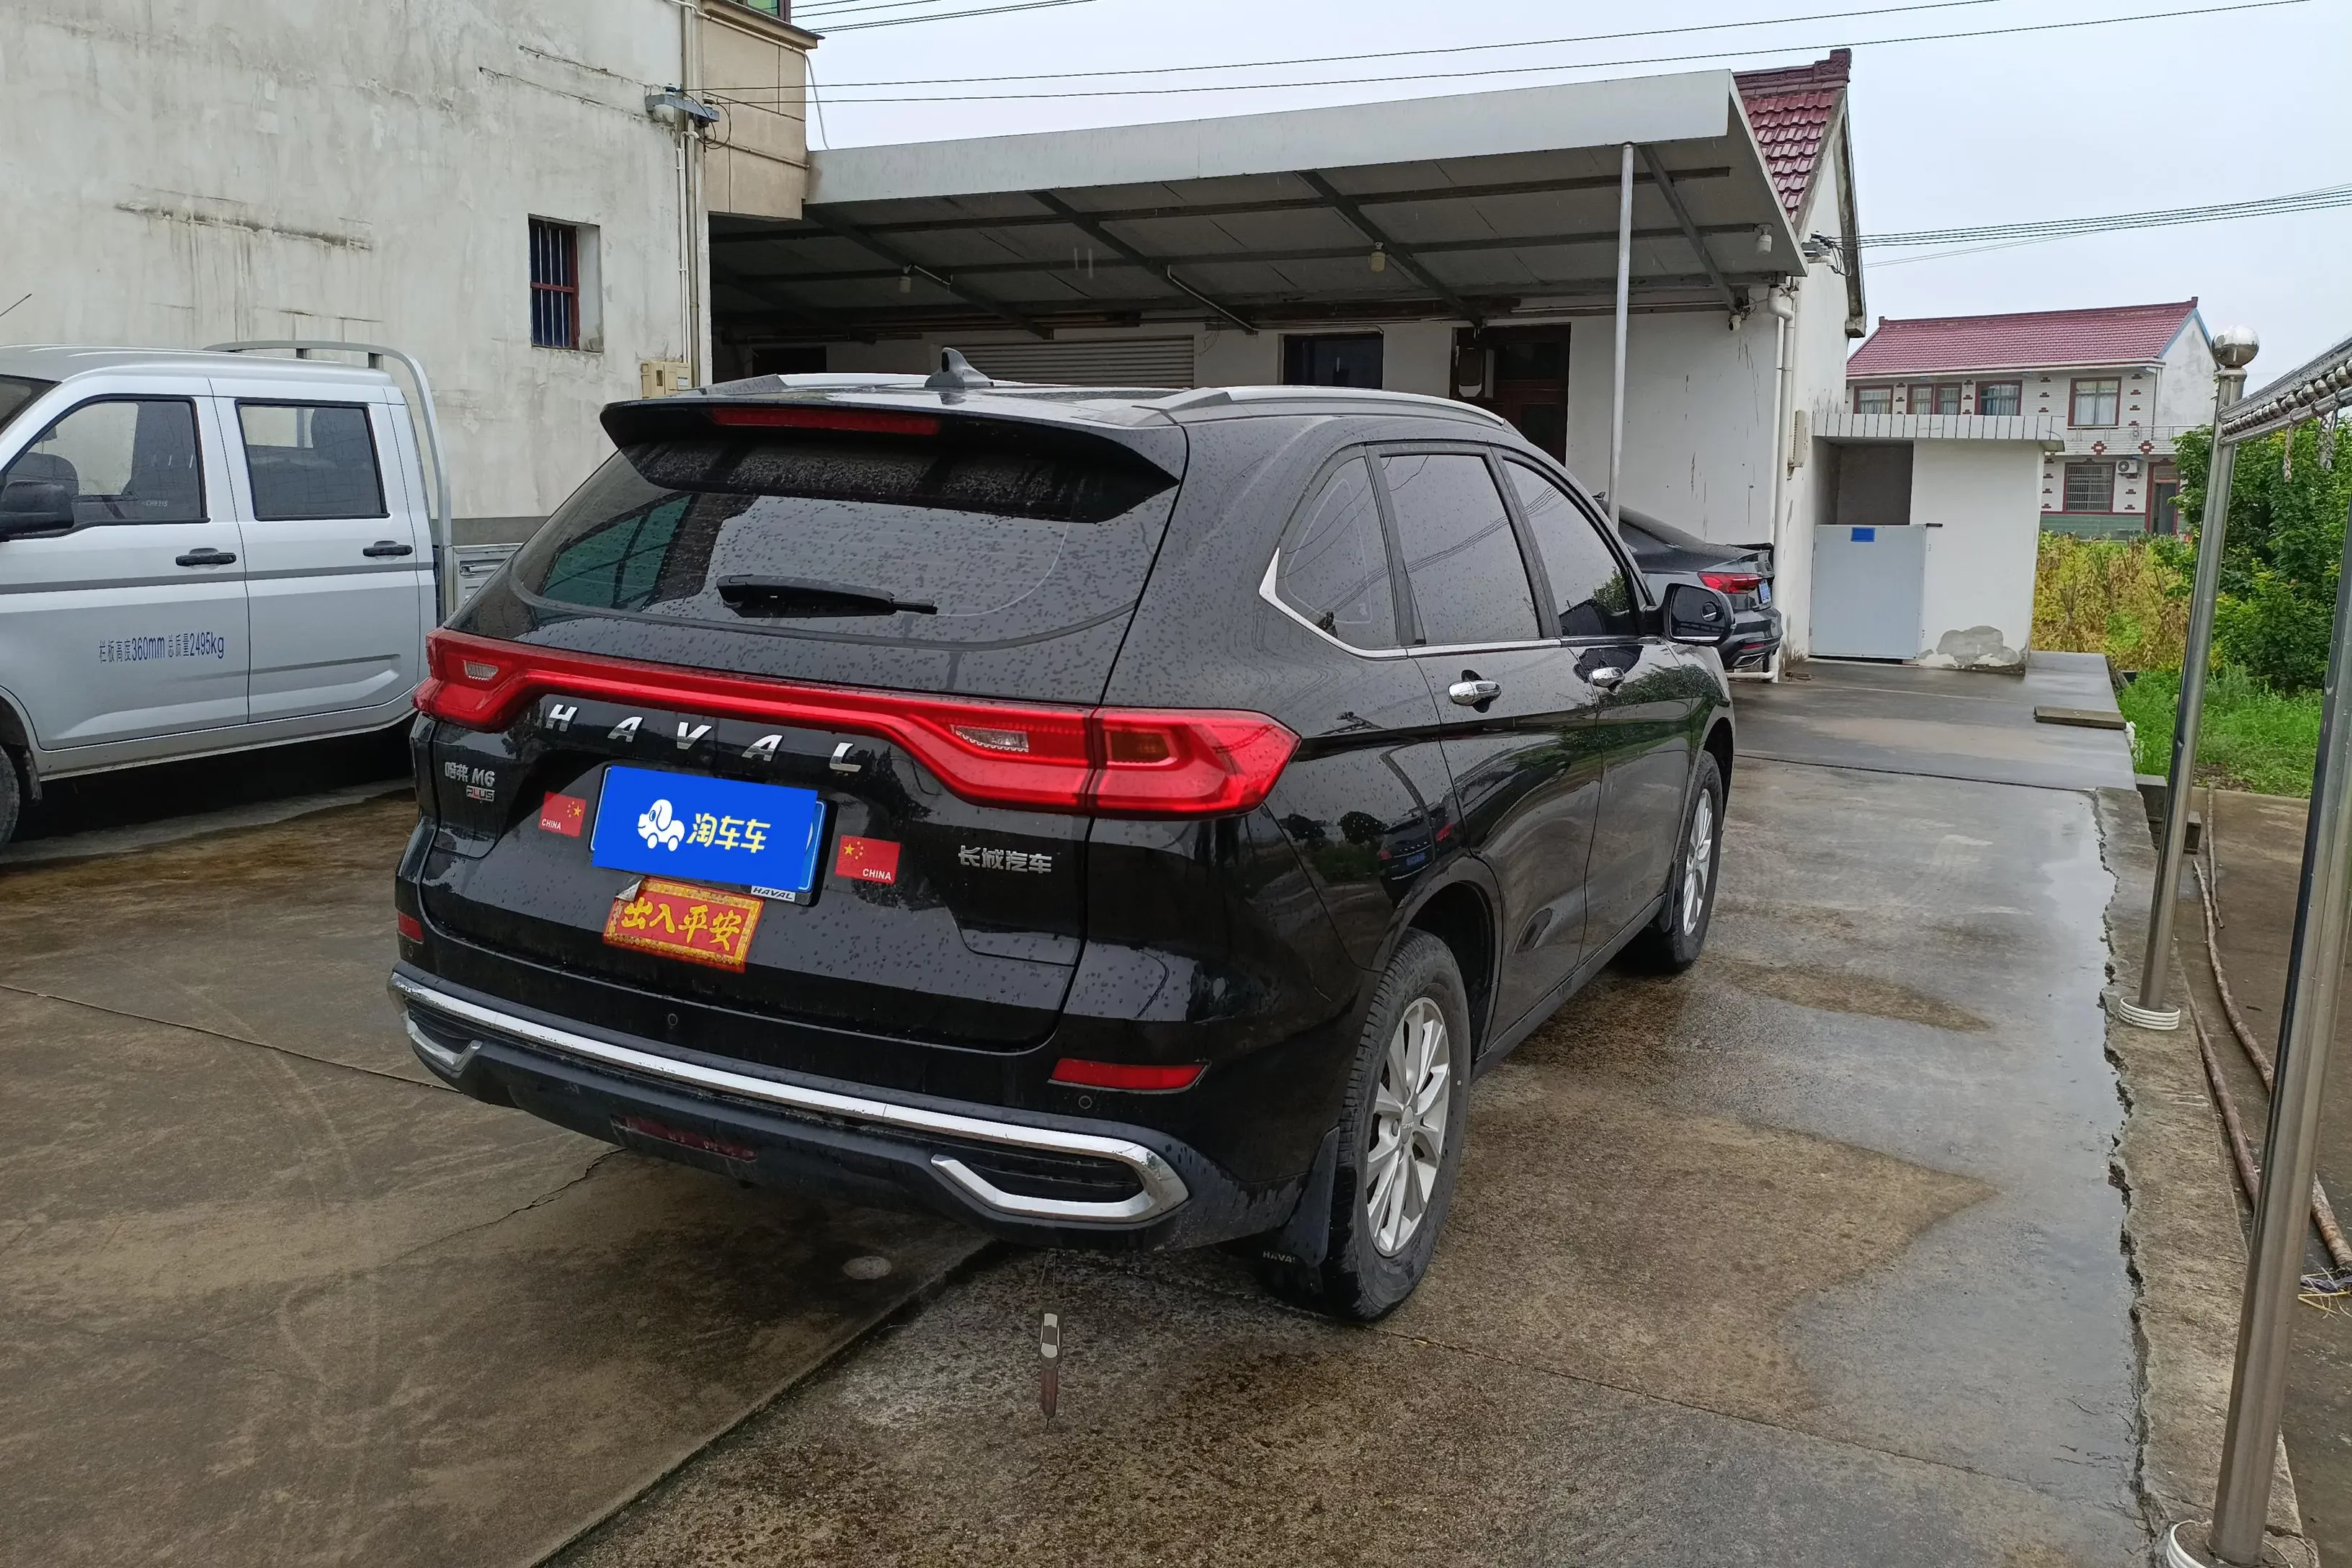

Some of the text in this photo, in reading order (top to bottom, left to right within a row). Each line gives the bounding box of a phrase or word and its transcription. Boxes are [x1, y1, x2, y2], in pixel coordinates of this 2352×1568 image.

[545, 703, 861, 772] HAVAL
[445, 762, 495, 787] 哈弗 M6
[466, 785, 495, 802] PLUS
[541, 818, 562, 831] CHINA
[958, 845, 1052, 874] 长城汽车
[863, 868, 891, 881] CHINA
[753, 886, 793, 900] HAVAL
[621, 896, 743, 951] 出入平安
